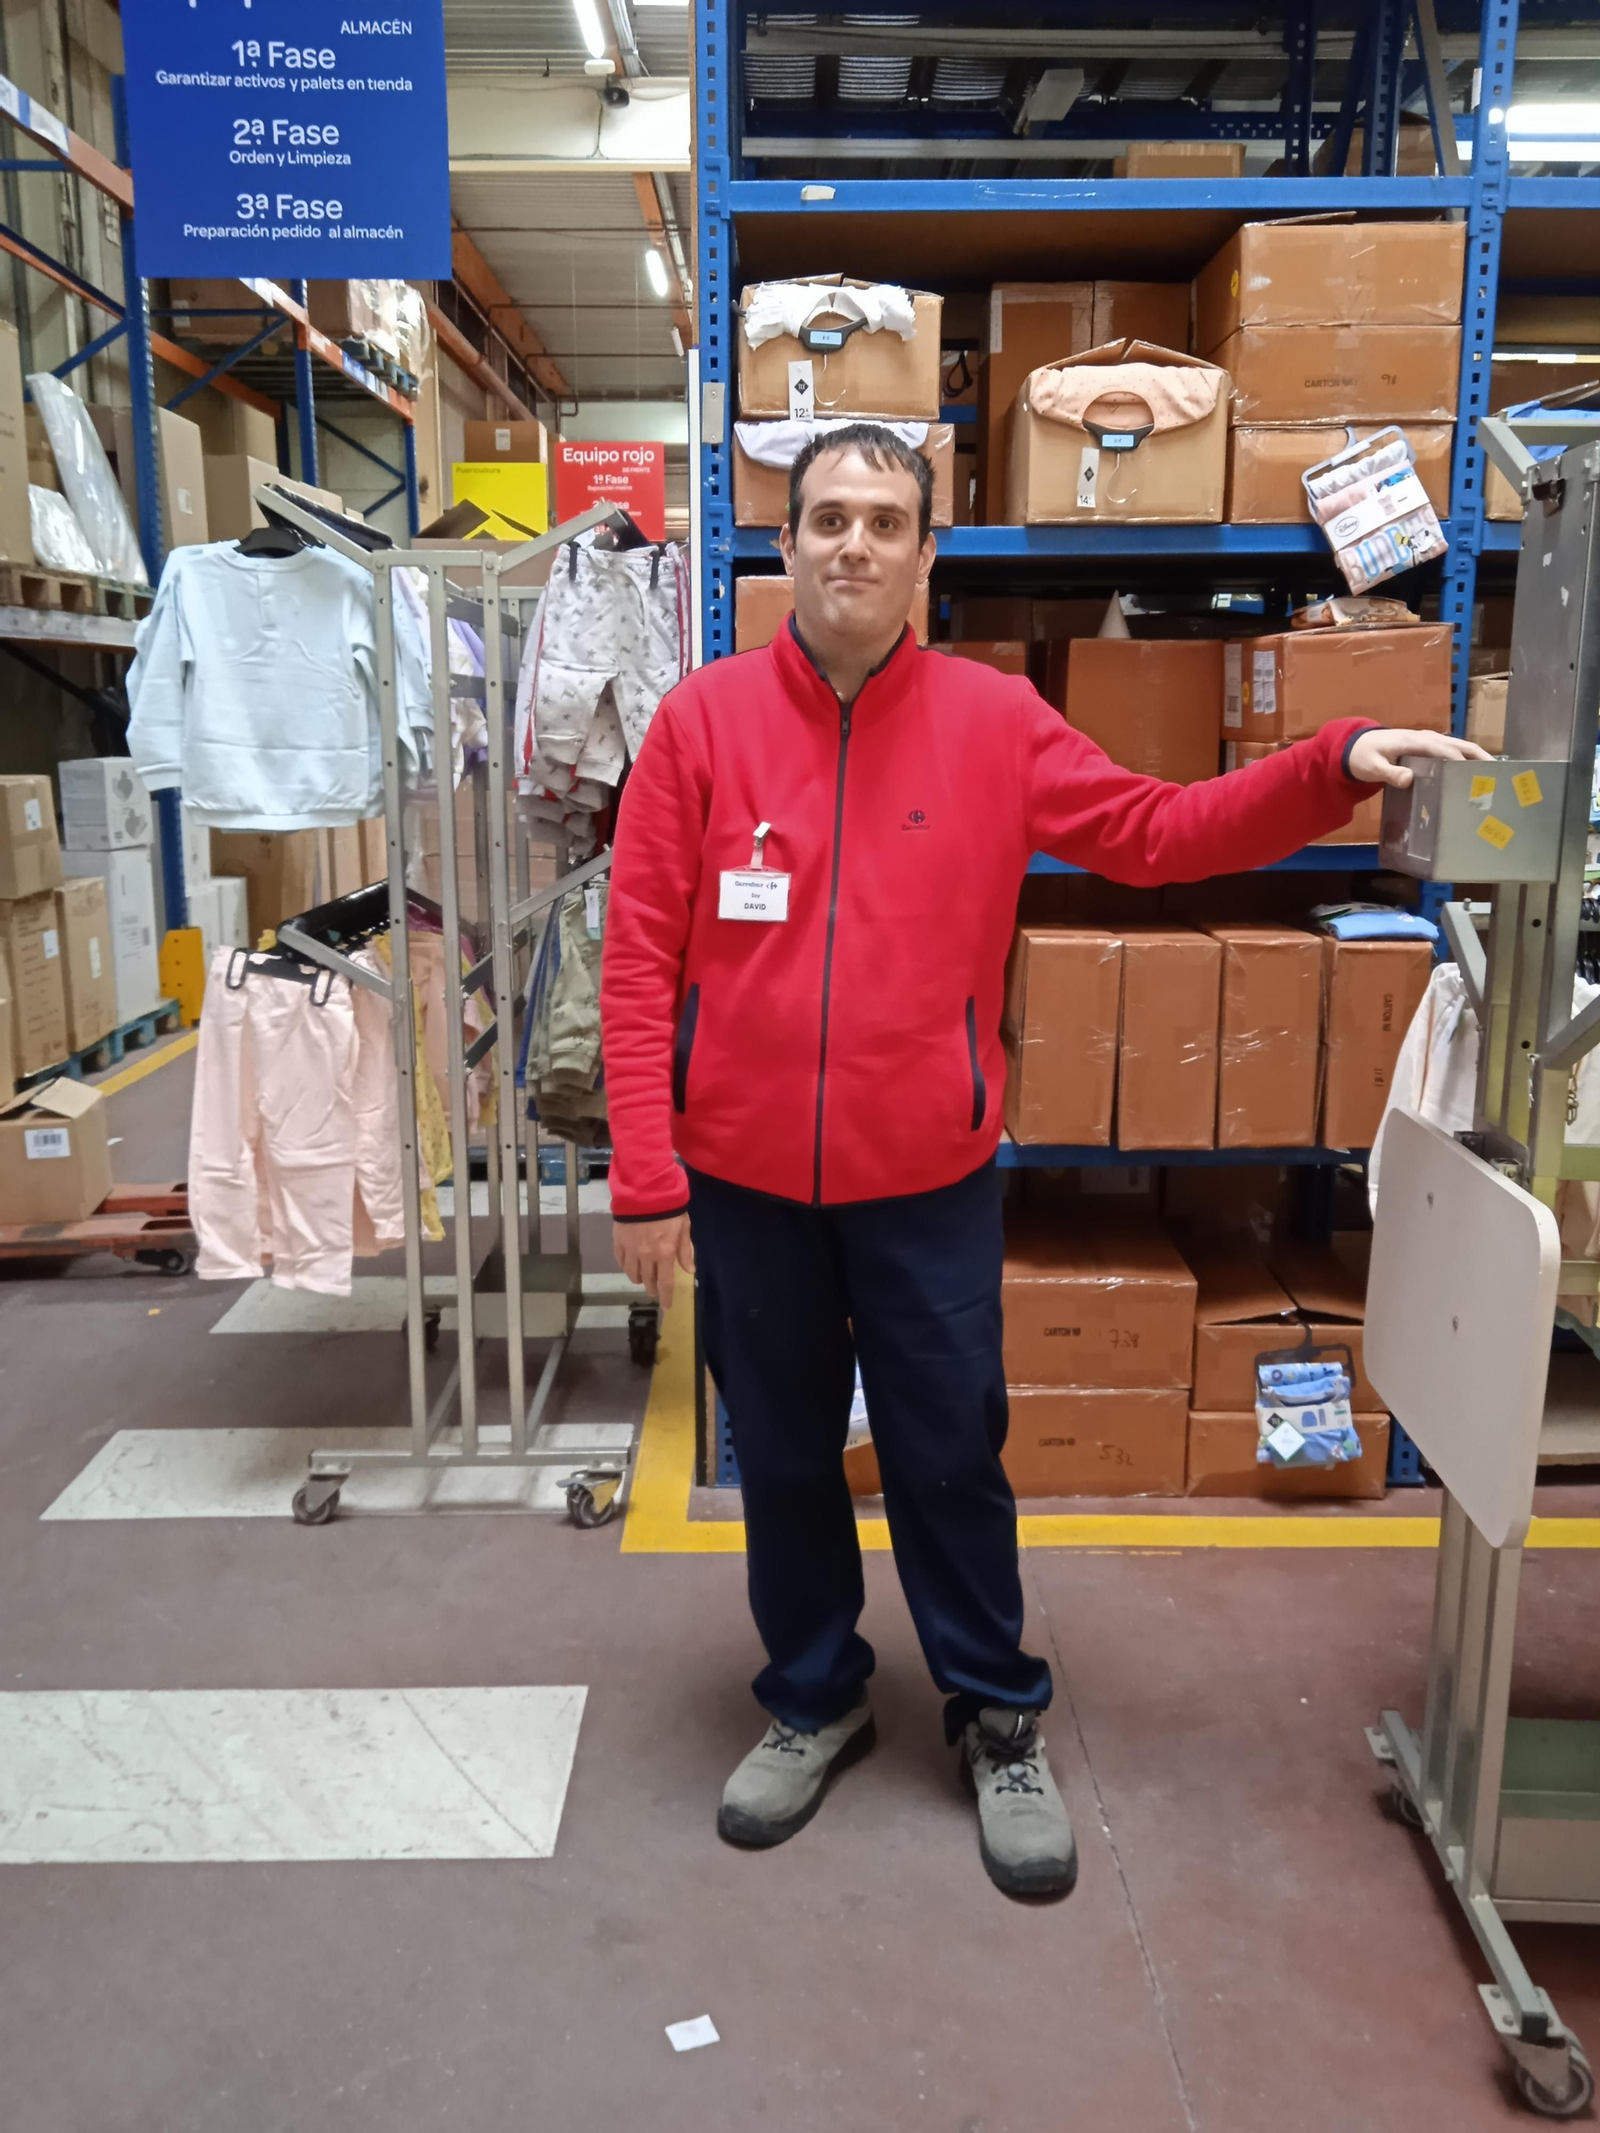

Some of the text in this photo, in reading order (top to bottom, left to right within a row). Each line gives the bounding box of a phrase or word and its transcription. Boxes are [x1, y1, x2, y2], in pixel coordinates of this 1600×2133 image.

[340, 18, 413, 35] ALMACÉN
[268, 41, 336, 69] Fase
[155, 70, 413, 92] Garantizar activos y palets en tienda
[273, 119, 340, 145] Fase
[229, 150, 351, 167] Orden y Limpieza
[277, 194, 343, 219] Fase
[183, 224, 404, 241] Preparación pedido al almacén
[1304, 379, 1340, 388] CARTON
[563, 446, 655, 466] Equipo rojo
[455, 466, 501, 474] Puericultura
[605, 474, 629, 484] Fase
[734, 880, 764, 888] Carrefour
[744, 902, 767, 911] DAVID
[1044, 1327, 1071, 1337] CARTON
[1038, 1438, 1065, 1447] CARTON
